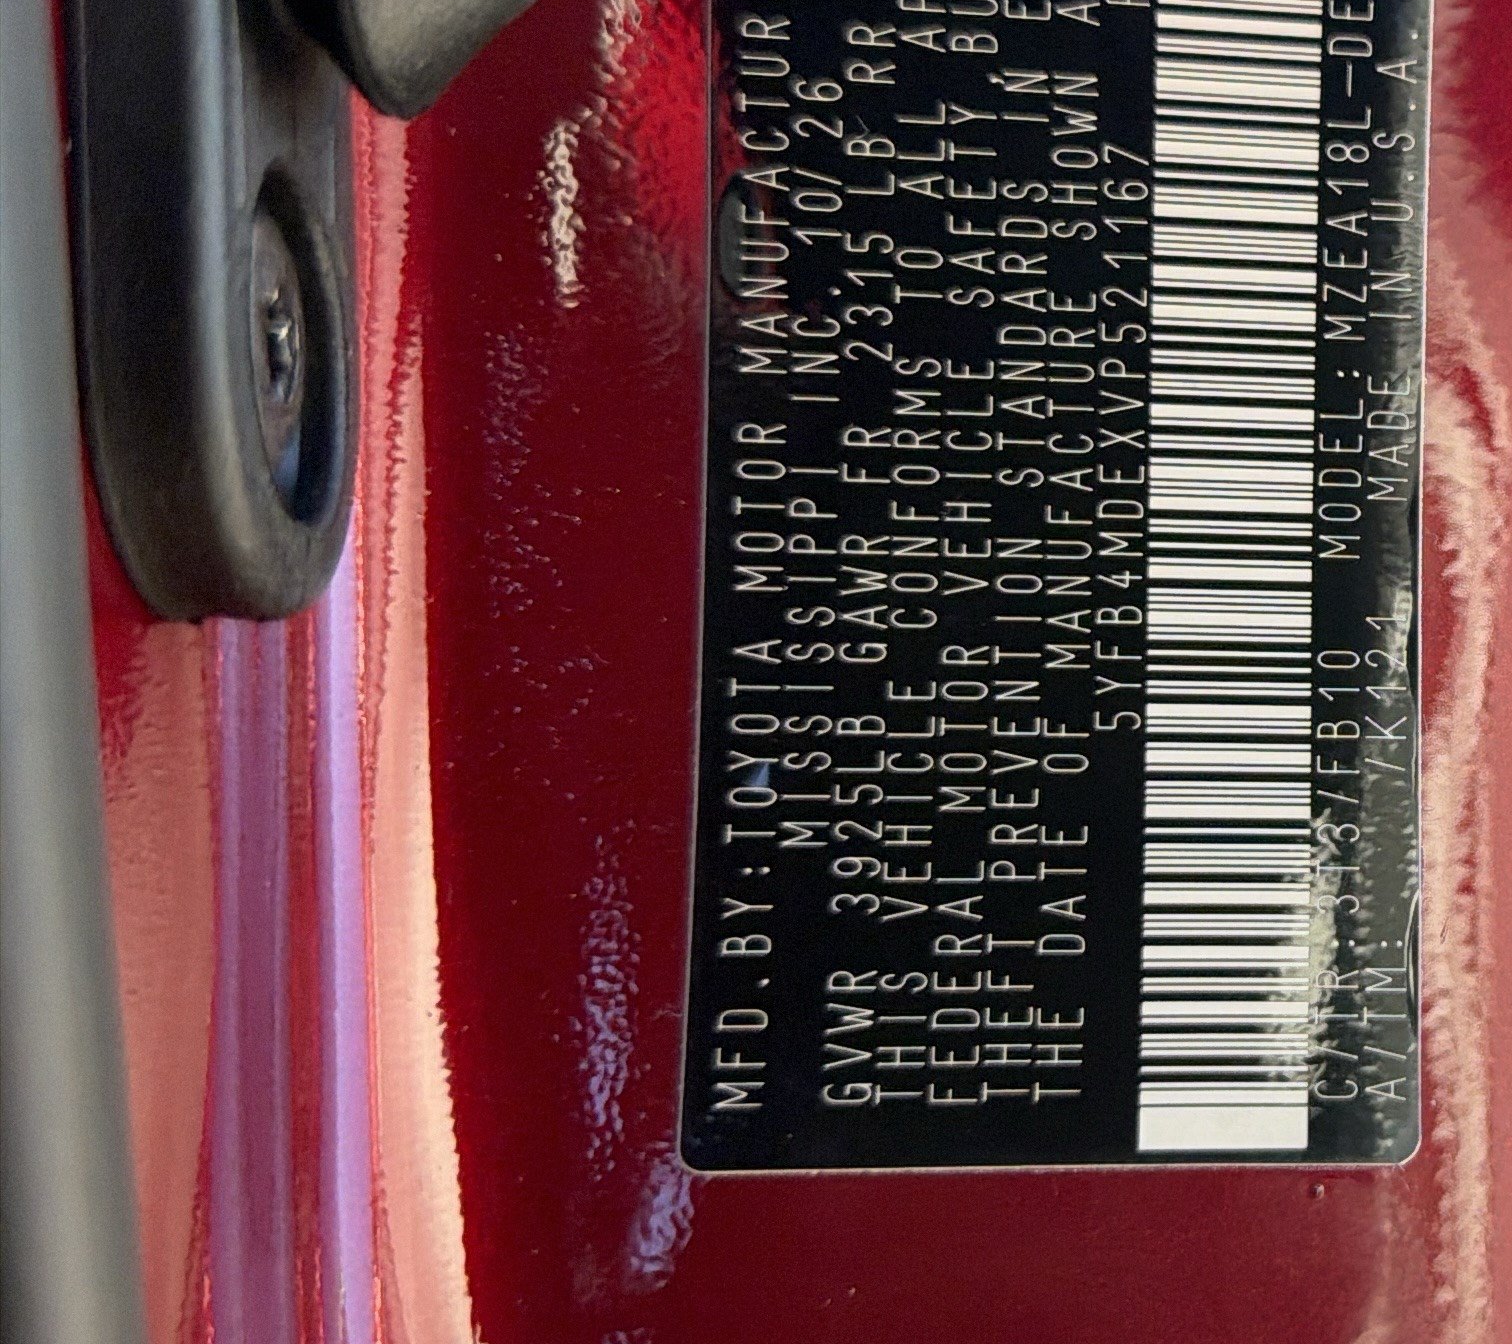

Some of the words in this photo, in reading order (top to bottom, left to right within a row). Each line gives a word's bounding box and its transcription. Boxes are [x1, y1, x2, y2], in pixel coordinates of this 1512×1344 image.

[847, 21, 896, 83] RR
[1000, 72, 1049, 120] IN
[847, 137, 895, 194] LB
[898, 102, 946, 198] ALL
[1052, 75, 1099, 240] SHOWN
[1371, 32, 1417, 220] U.S.A.
[790, 287, 841, 402] INC.
[846, 233, 893, 359] 2315
[895, 249, 943, 304] TO
[998, 182, 1049, 486] STANDARDS
[1370, 270, 1412, 319] IN
[735, 423, 787, 591] MOTOR
[842, 425, 890, 483] FR
[894, 357, 942, 628] CONFORMS
[944, 359, 994, 594] VEHICLE
[1046, 293, 1097, 666] MANUFACTURE
[1095, 142, 1149, 731] 5YFB4MDEXVP521167
[1367, 375, 1411, 501] MADE
[779, 467, 838, 846] MISSISSIPPI
[839, 535, 889, 662] GAWR
[939, 645, 989, 810] MOTOR
[993, 539, 1045, 879] PREVENTION
[1041, 719, 1088, 773] OF
[1365, 616, 1406, 771] /K121
[881, 680, 936, 922] VEHICLE
[1038, 827, 1088, 955] DATE
[824, 971, 877, 1103] GVWR
[876, 972, 927, 1104] THIS
[930, 861, 985, 1104] FEDERAL
[985, 935, 1035, 1100] THEFT
[1364, 939, 1406, 1101] A/TM:
[1034, 1008, 1083, 1101] THE
